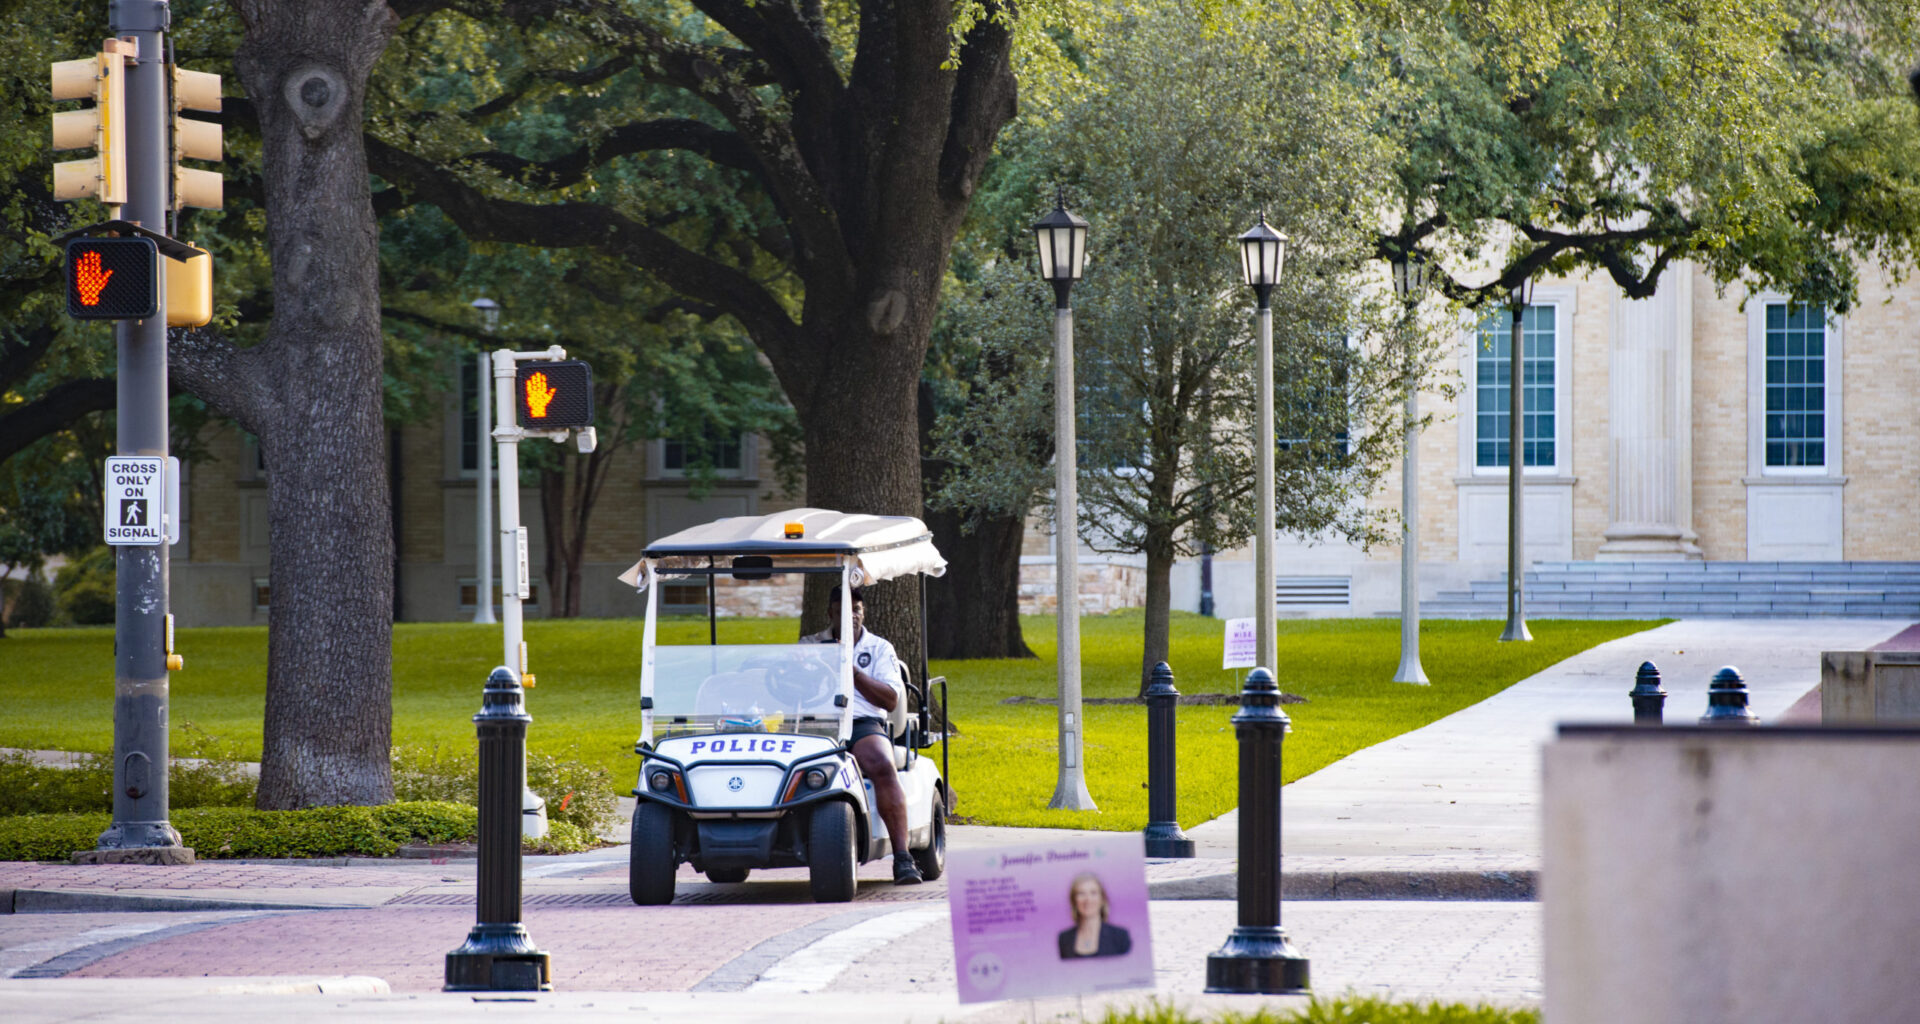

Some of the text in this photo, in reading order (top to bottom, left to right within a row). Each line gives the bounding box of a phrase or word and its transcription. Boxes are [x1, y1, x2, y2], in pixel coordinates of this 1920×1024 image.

[112, 464, 158, 473] CROSS
[116, 476, 152, 485] ONLY
[124, 488, 144, 497] ON
[109, 528, 158, 538] SIGNAL
[690, 739, 796, 754] POLICE
